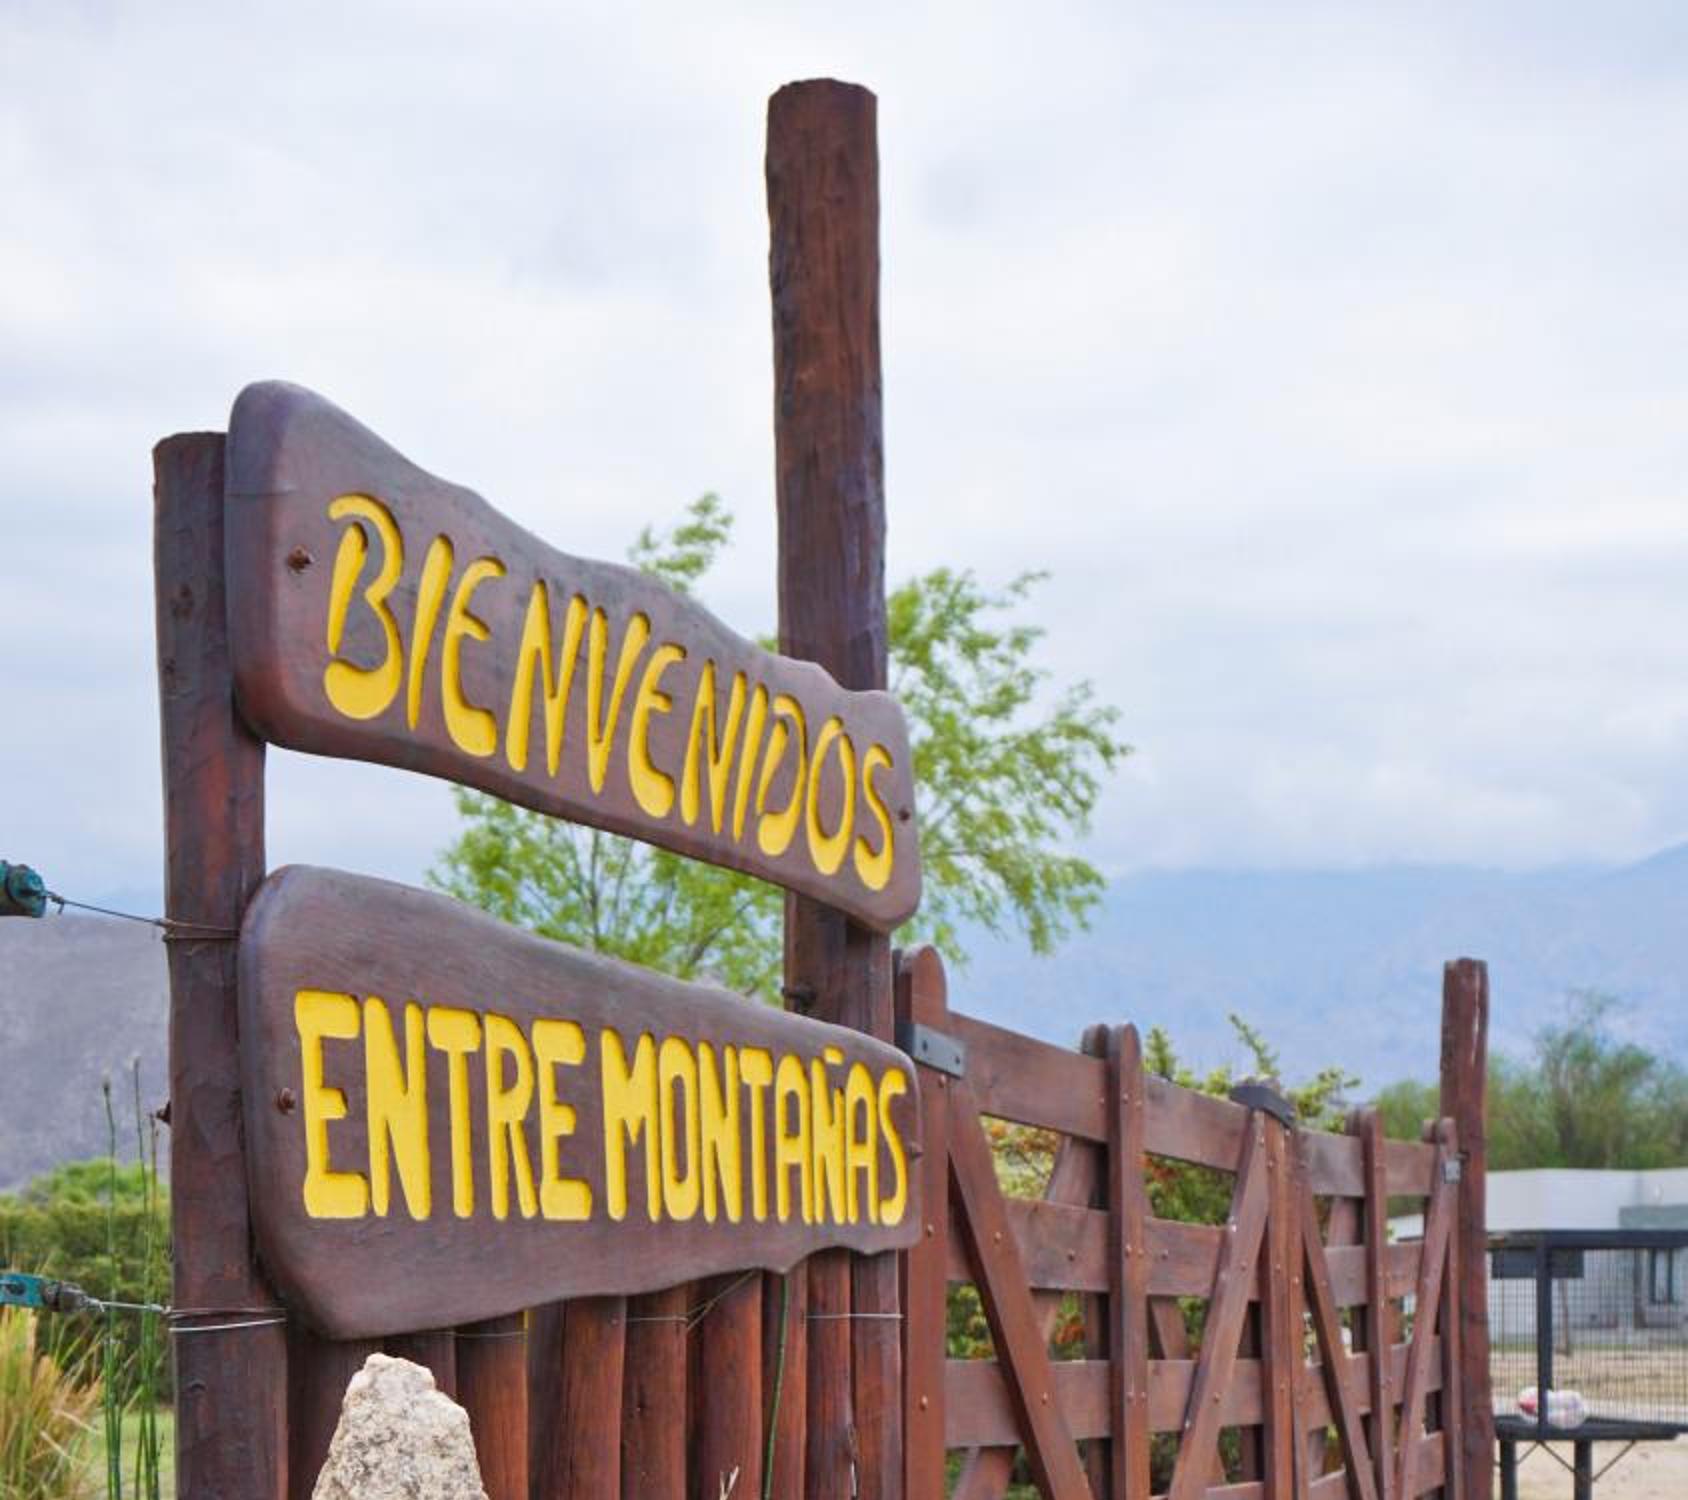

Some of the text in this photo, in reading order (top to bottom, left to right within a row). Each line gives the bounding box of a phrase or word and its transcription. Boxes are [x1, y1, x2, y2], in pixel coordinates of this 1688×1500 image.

[324, 493, 895, 891] BIENVENIDOS
[294, 989, 907, 1225] ENTRE MONTAÑAS
